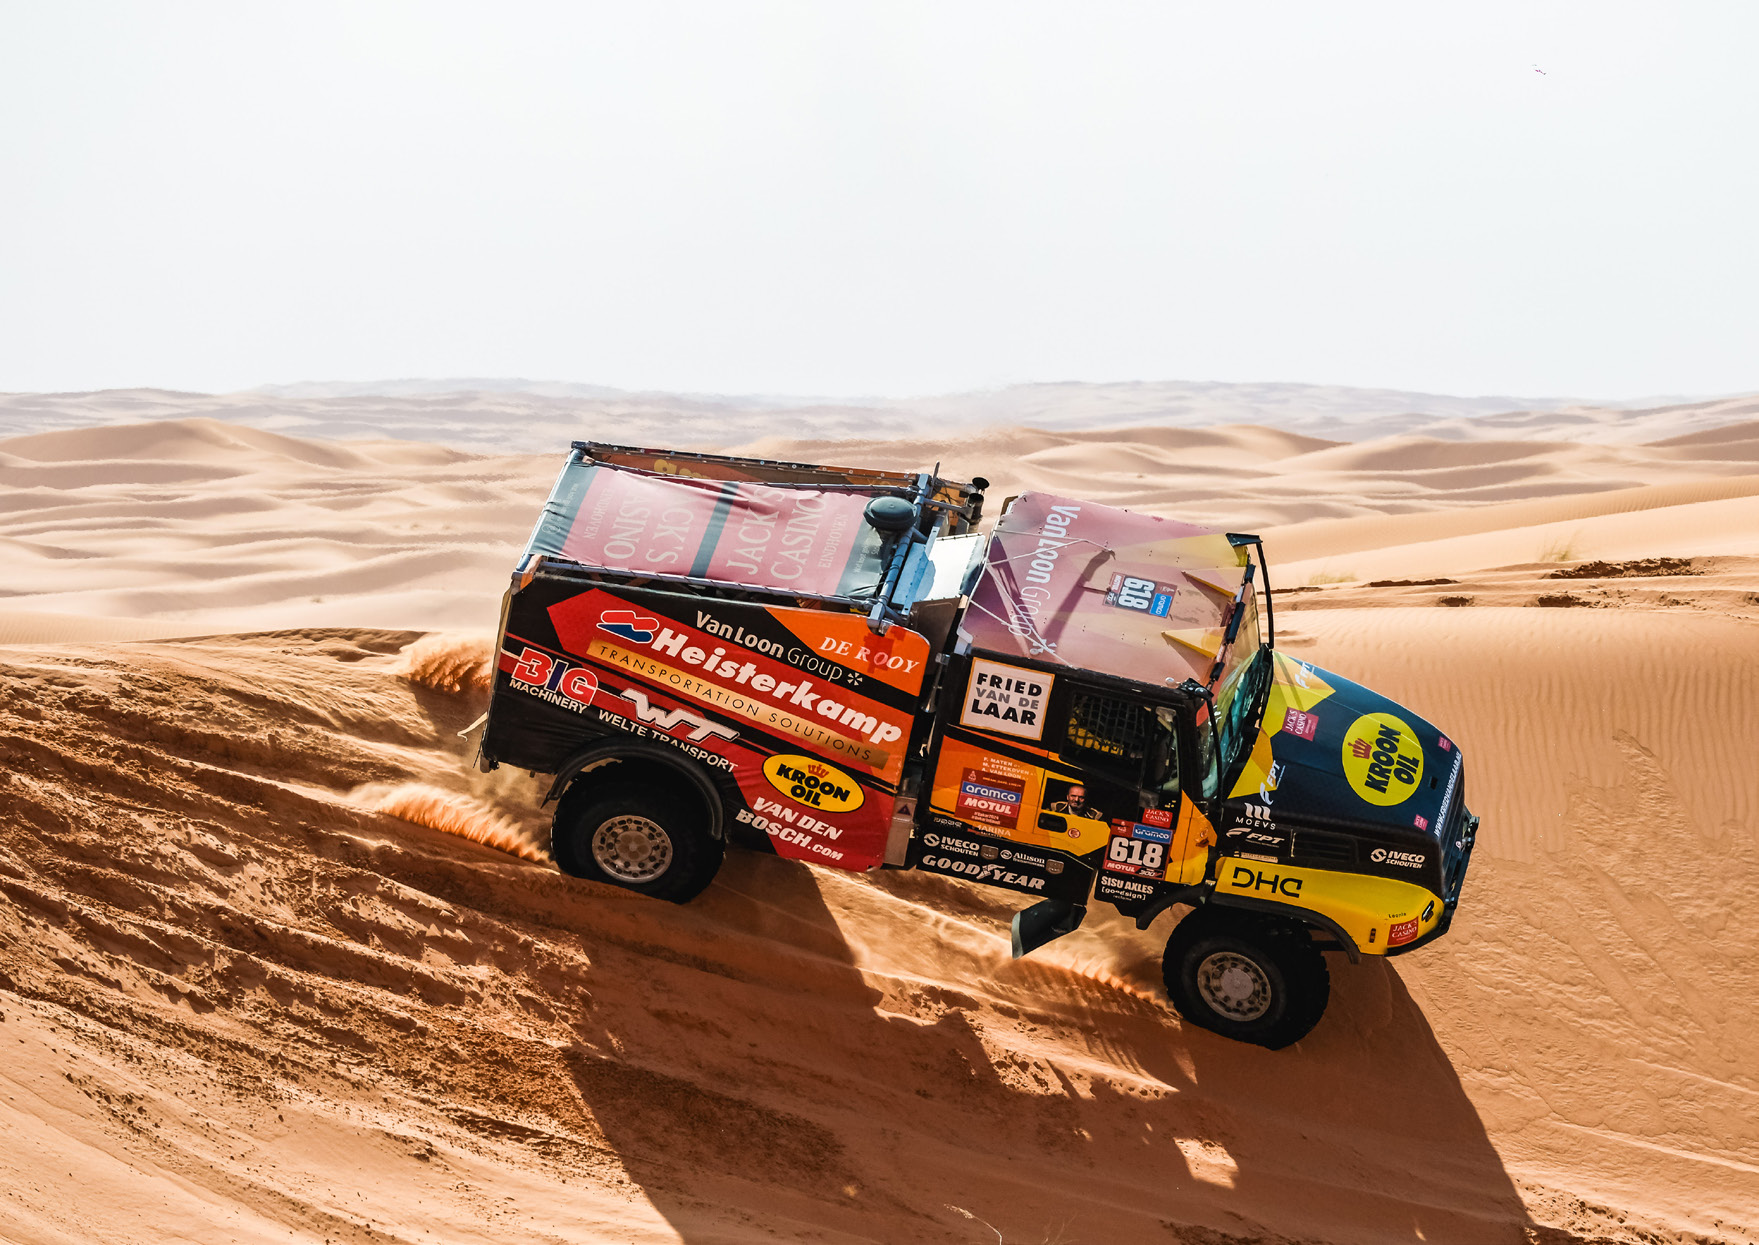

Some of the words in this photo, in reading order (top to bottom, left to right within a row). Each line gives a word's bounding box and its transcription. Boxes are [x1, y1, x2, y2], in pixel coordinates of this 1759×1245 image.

[770, 497, 827, 580] CASINO
[819, 513, 849, 569] EINDHOVEN
[1118, 577, 1156, 610] 618
[787, 647, 843, 682] Group
[819, 636, 852, 656] DE
[854, 649, 920, 674] ROOY
[511, 646, 598, 706] BIG
[651, 628, 902, 744] Heisterkamp
[977, 673, 1042, 697] FRIED
[508, 679, 588, 714] MACHINERY
[599, 645, 760, 716] TRANSPORTATION
[769, 712, 872, 760] SOLUTIONS
[976, 687, 1010, 704] VAN
[1018, 697, 1039, 710] DE
[971, 699, 1036, 726] LAAR
[1294, 713, 1307, 735] CASINO
[598, 709, 647, 737] WELTE
[651, 729, 739, 773] TRANSPORT
[990, 758, 1013, 767] MATEN
[1364, 723, 1402, 794] KROON
[1393, 754, 1420, 785] OIL
[776, 764, 850, 802] KROON
[1003, 771, 1022, 779] LOON
[1266, 759, 1281, 787] FPT
[790, 785, 822, 807] OIL
[965, 784, 1017, 802] aramco
[752, 796, 799, 824] VAN
[797, 814, 843, 840] DEN
[964, 797, 1012, 815] MOTUL
[1145, 814, 1169, 823] CASINO
[1235, 816, 1276, 830] MOEVS
[735, 808, 844, 861] BOSCH.COM
[941, 836, 980, 851] IVECO
[1246, 833, 1285, 844] FPT
[940, 844, 979, 857] SCHOUTEN
[1013, 852, 1045, 864] Allison
[1110, 836, 1163, 868] 618
[1387, 850, 1426, 863] IVECO
[1107, 862, 1135, 873] MOTUL
[1385, 858, 1422, 869] SCHOUTEN
[1101, 875, 1124, 889] SISU
[1124, 880, 1154, 895] AXLES
[1391, 926, 1417, 938] CASINO
